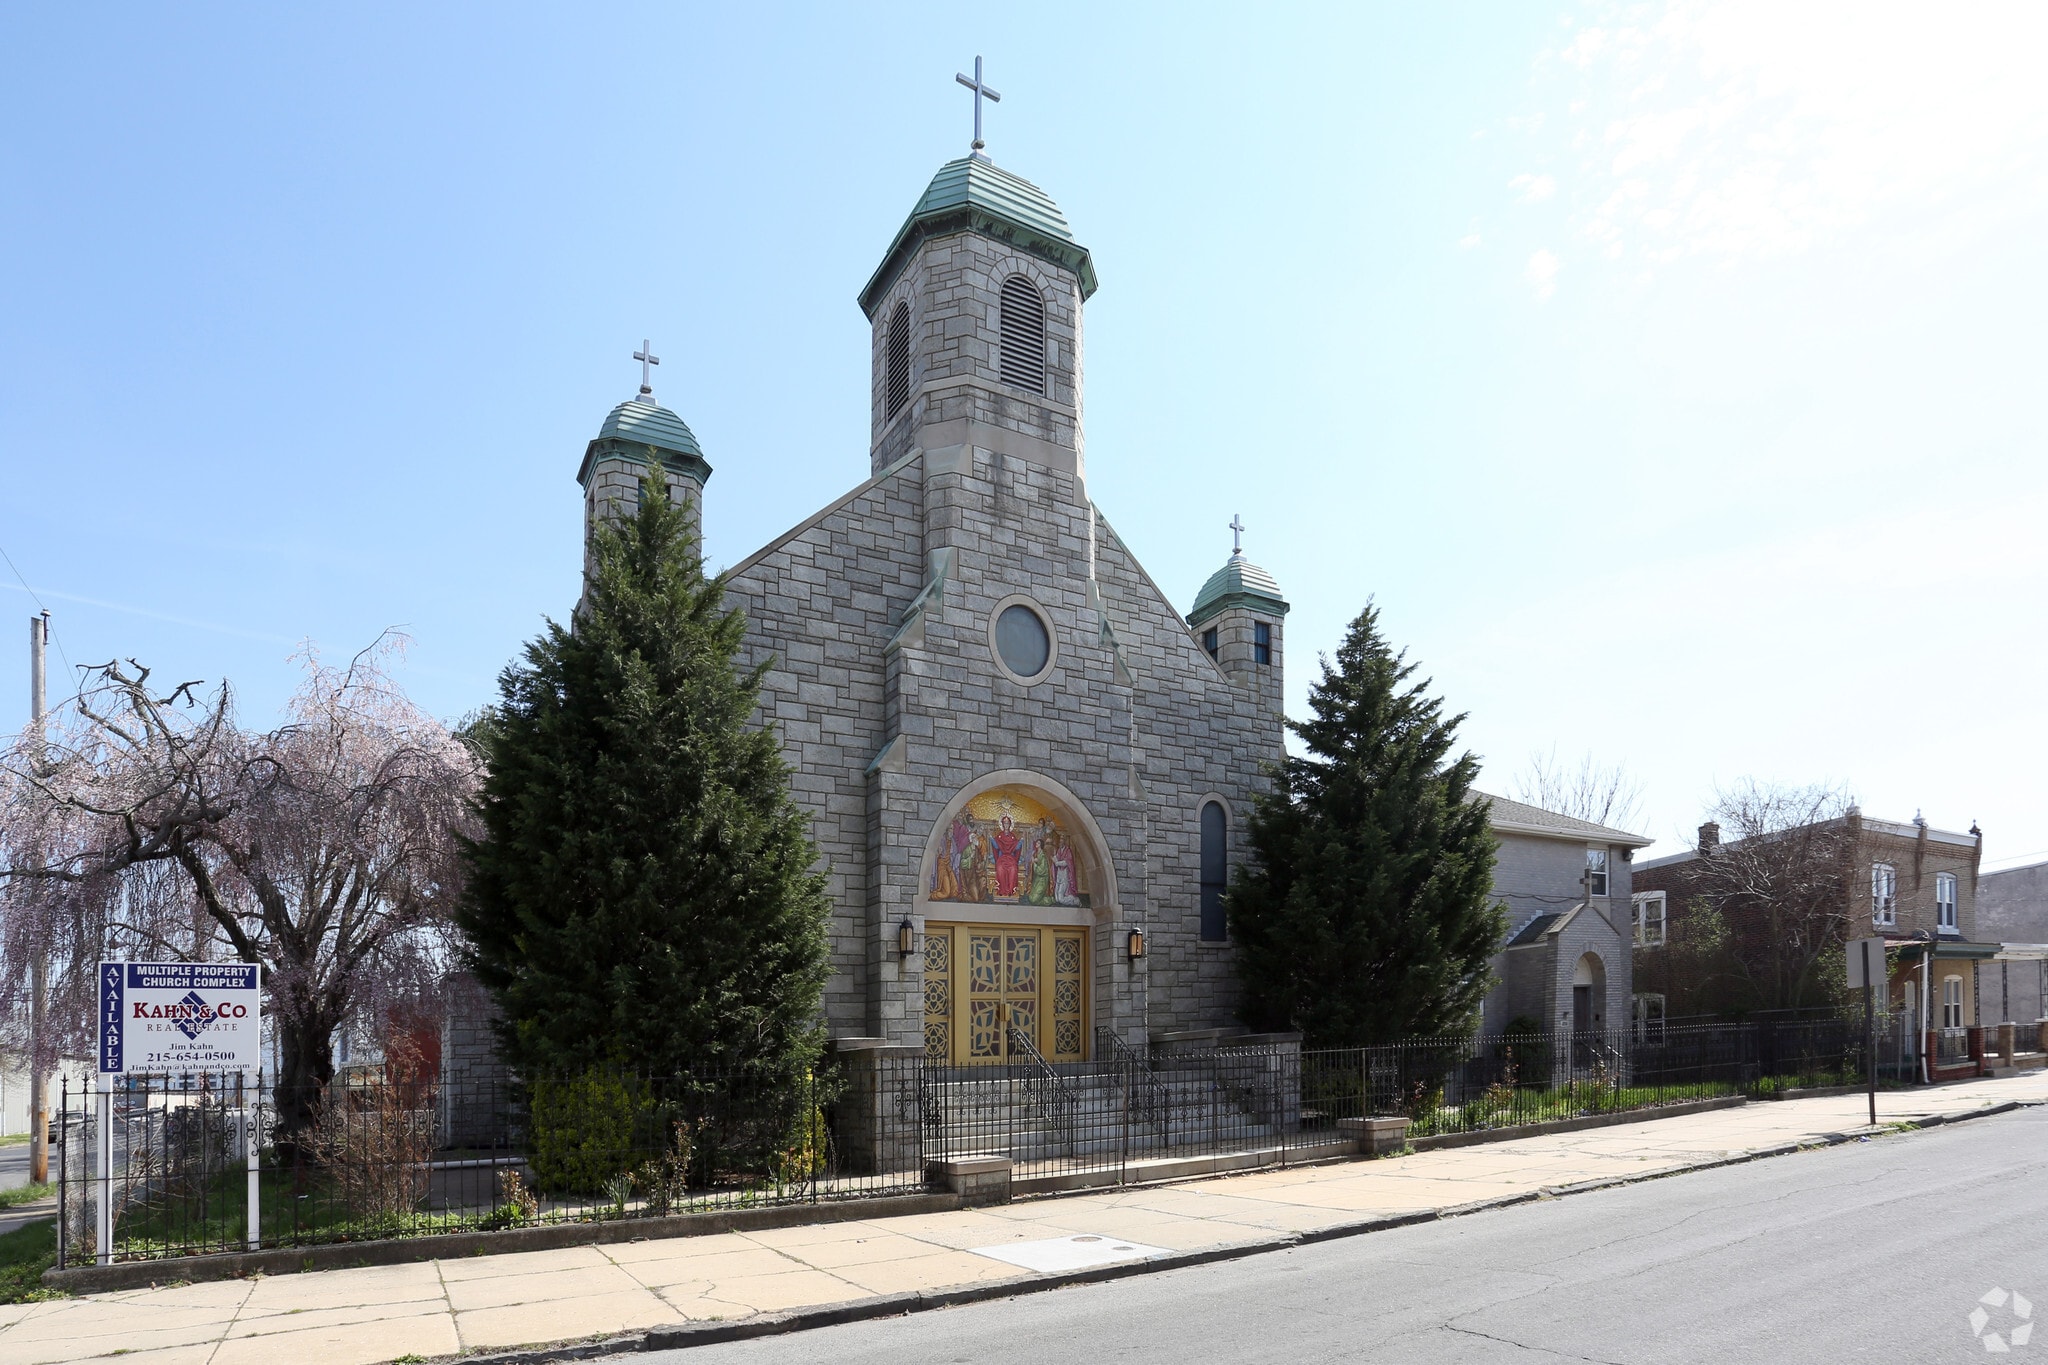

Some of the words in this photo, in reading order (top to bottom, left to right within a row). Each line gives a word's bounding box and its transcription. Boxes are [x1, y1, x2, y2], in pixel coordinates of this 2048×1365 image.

[137, 966, 191, 976] MULTIPLE
[194, 967, 251, 977] PROPERTY
[142, 977, 190, 987] CHURCH
[193, 977, 245, 987] COMPLEX
[133, 1002, 192, 1018] KAHN
[199, 1004, 212, 1018] &
[106, 967, 119, 1069] AVAILABLE
[147, 1023, 180, 1031] REAL
[188, 1023, 238, 1031] ESTATE
[147, 1052, 235, 1062] 215-654-0500
